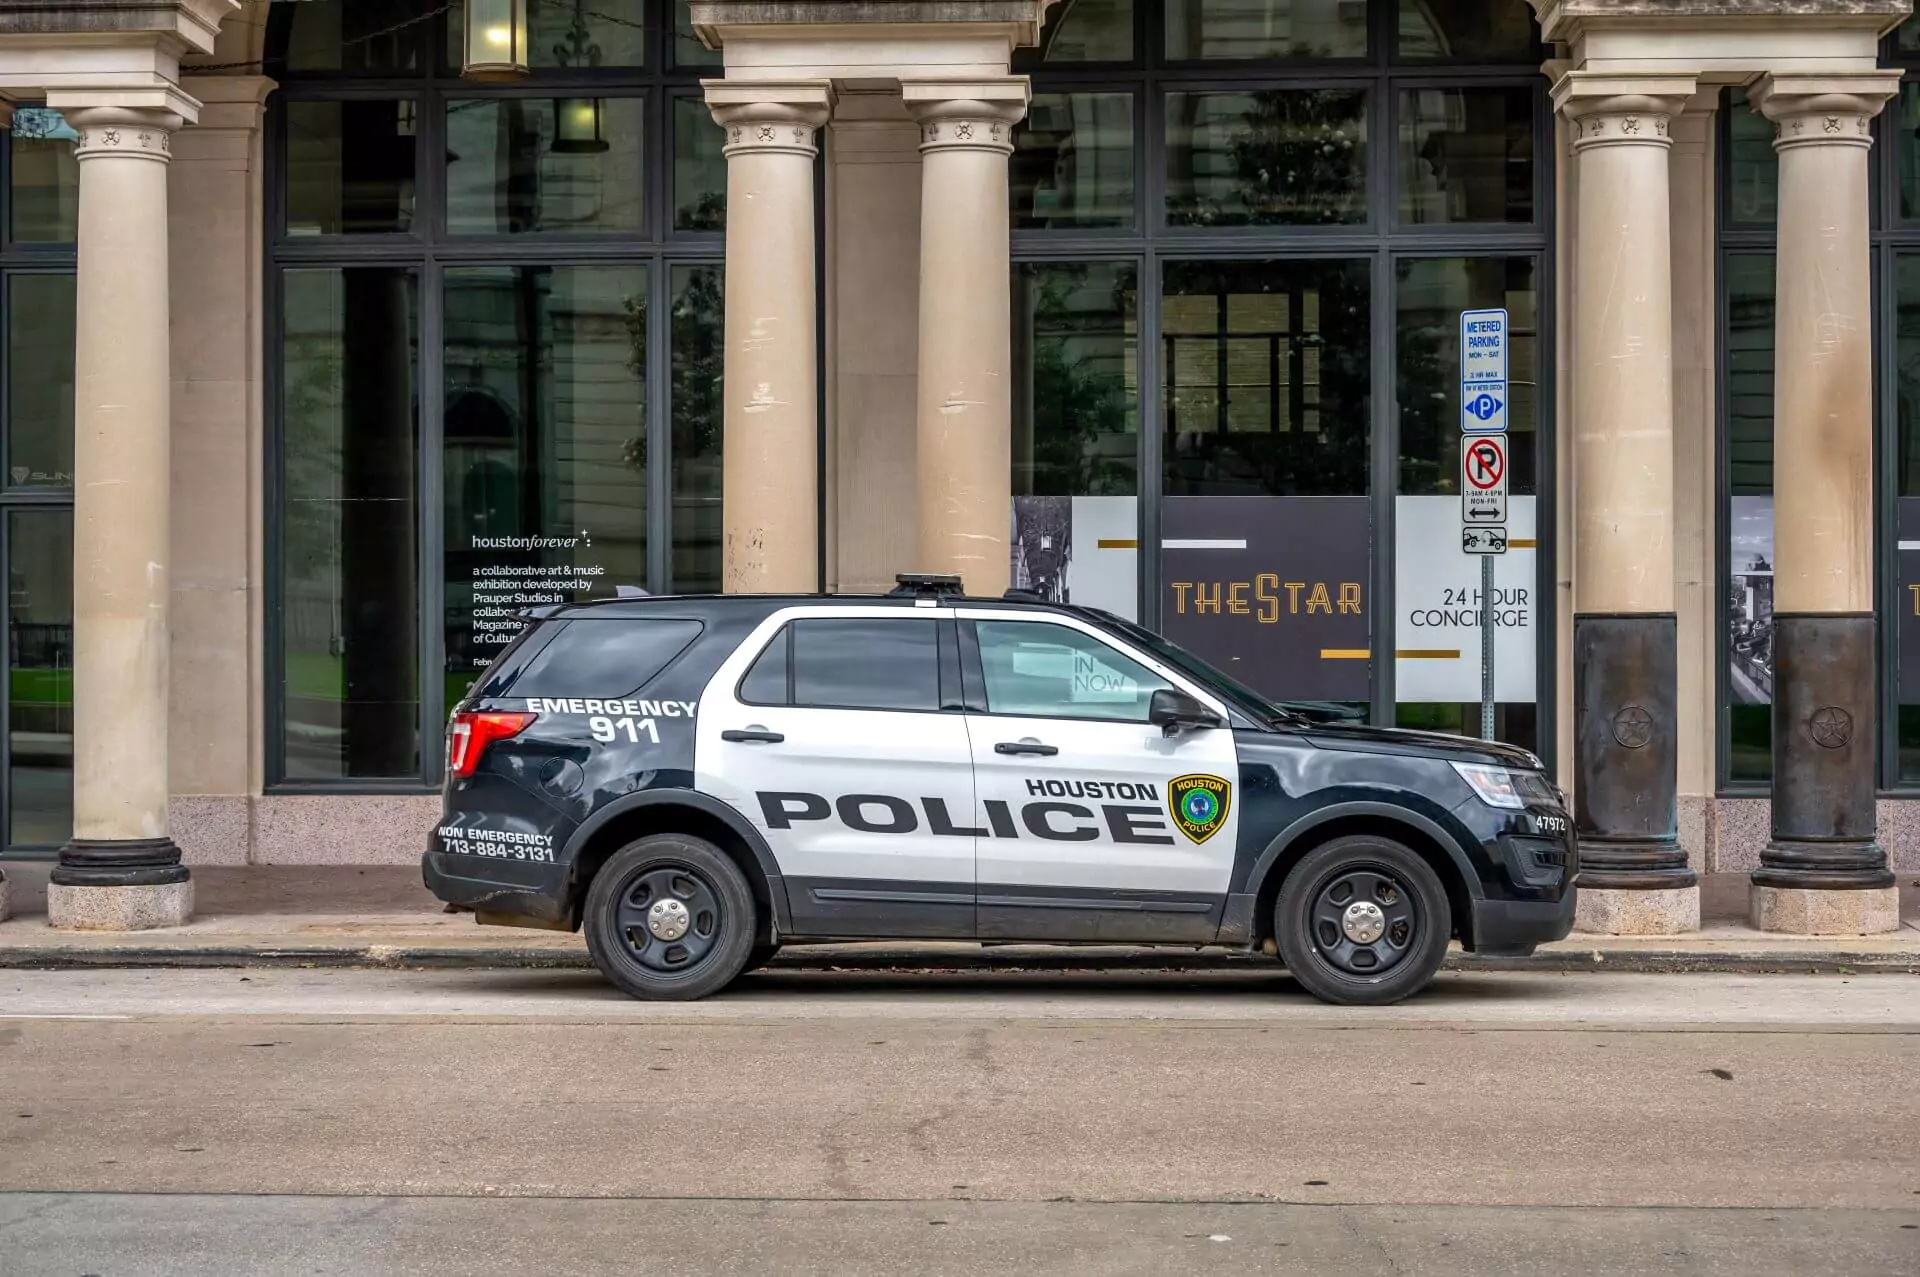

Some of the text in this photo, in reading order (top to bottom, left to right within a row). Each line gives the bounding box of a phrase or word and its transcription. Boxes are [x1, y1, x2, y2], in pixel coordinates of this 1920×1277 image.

[1466, 320, 1502, 333] METERED
[1468, 336, 1500, 347] PARKING
[1470, 497, 1498, 505] MON-FRI
[472, 565, 605, 576] a collaborative art & music
[472, 579, 592, 592] exhibition developed by
[472, 592, 564, 605] Prauper Studios in
[1443, 588, 1528, 606] 24 HOUR
[472, 619, 523, 632] Magazine
[472, 633, 484, 644] of
[1074, 656, 1094, 673] IN
[1074, 675, 1126, 692] NOW
[526, 698, 697, 718] EMERGENCY
[589, 716, 660, 744] 911
[1025, 779, 1159, 801] HOUSTON
[1176, 779, 1224, 792] HOUSTON
[755, 791, 1175, 846] POLICE
[1536, 815, 1566, 831] 47972
[1183, 820, 1216, 833] POLICE
[438, 826, 553, 847] NON EMERGENCY
[443, 838, 555, 862] 713-884-3131
